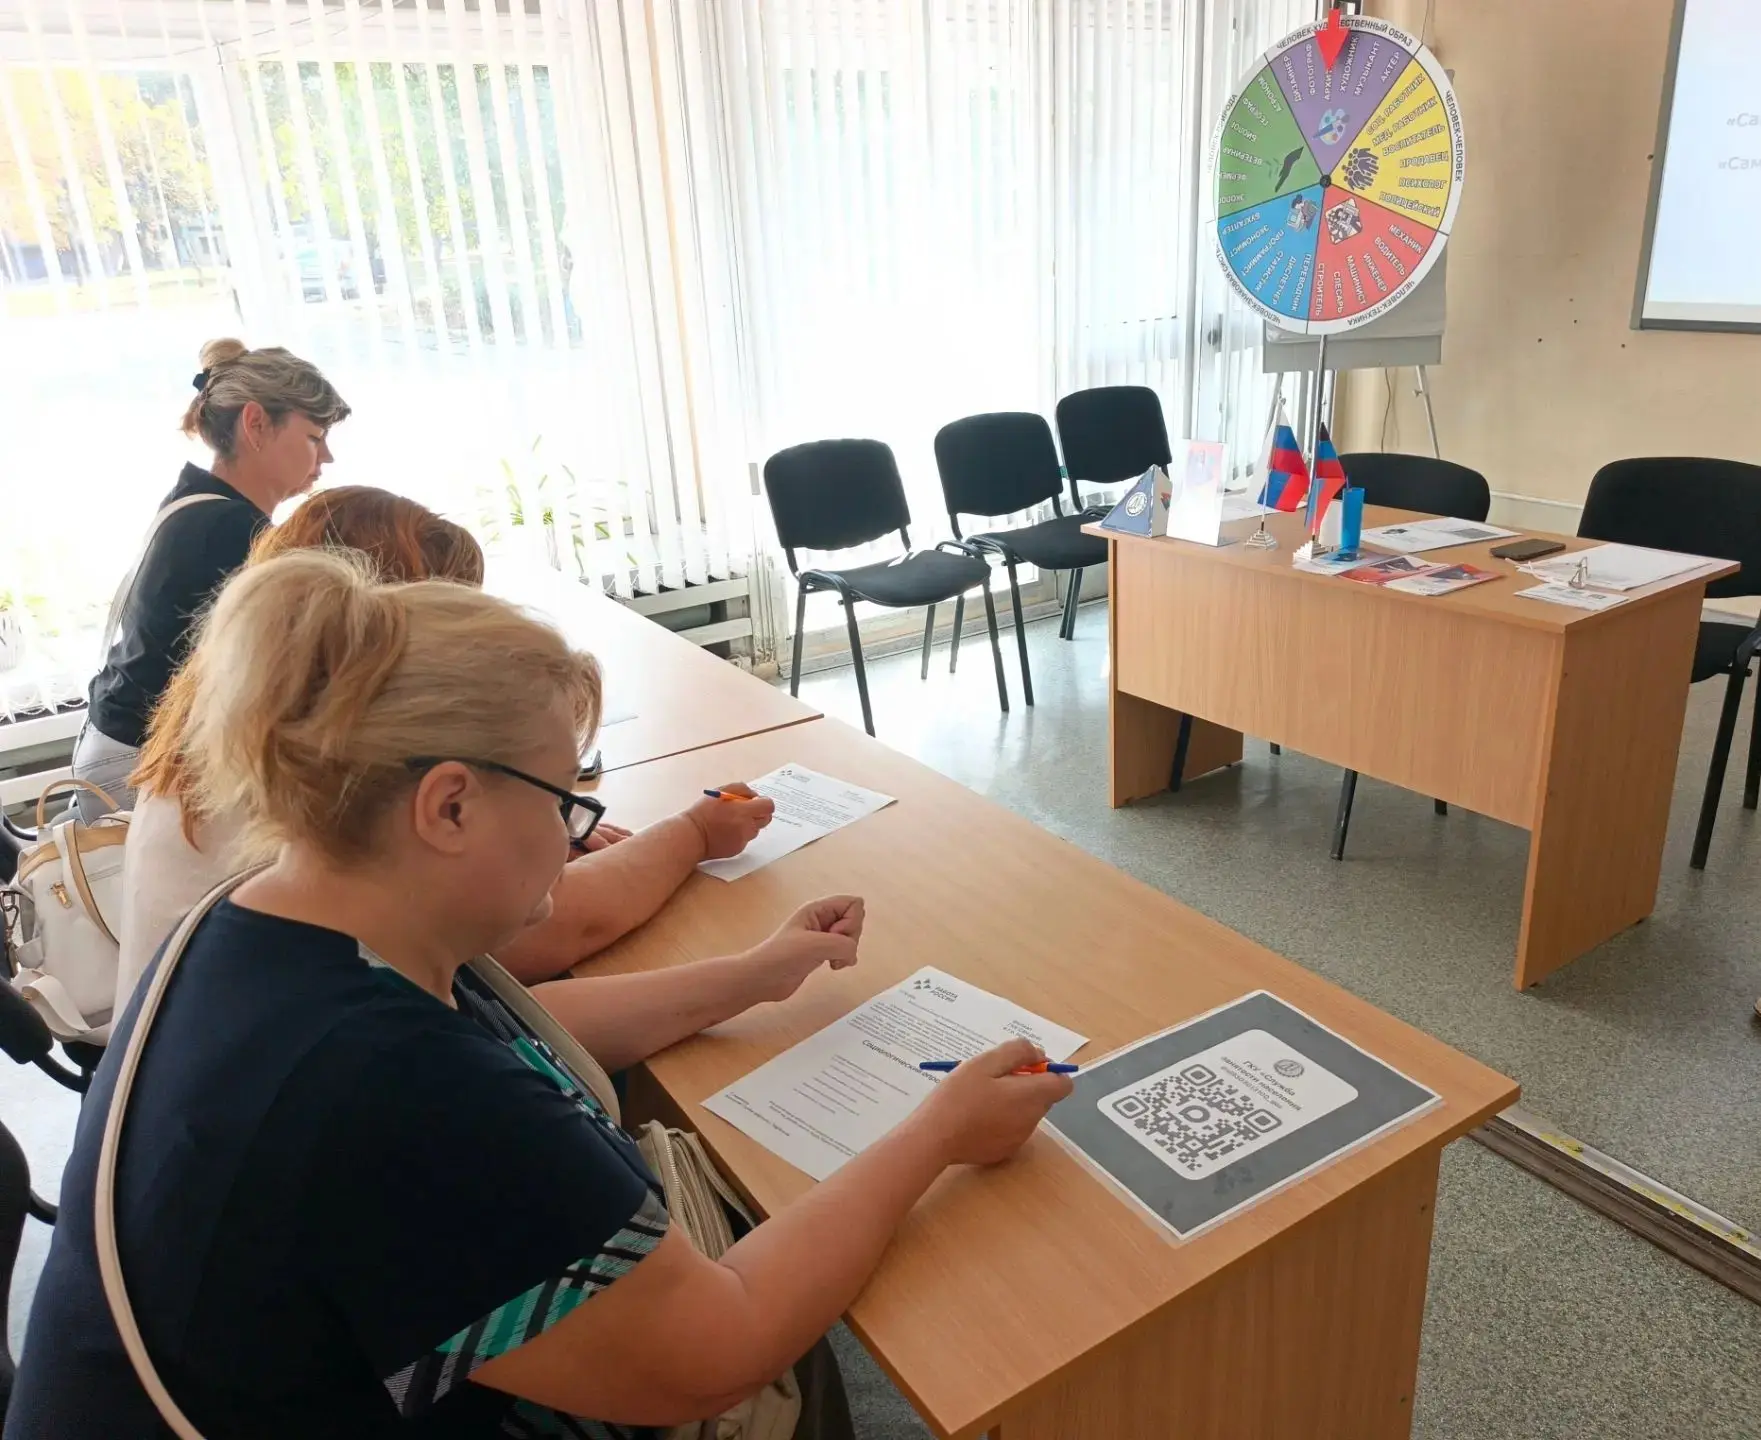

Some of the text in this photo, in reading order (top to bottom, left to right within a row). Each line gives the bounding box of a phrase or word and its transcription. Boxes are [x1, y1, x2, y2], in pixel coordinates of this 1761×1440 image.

[1277, 19, 1413, 49] ЧЕЛОВЕК-ХУДЕСТВЕННЫЙ ОБРАЗ
[1283, 55, 1303, 102] ДИЗАЙНЕР
[1305, 43, 1316, 96] ФОТОГРАФ
[1340, 37, 1359, 93] ХУДОЖНИК
[1354, 41, 1381, 96] МУЗЫКАНТ
[1380, 51, 1401, 82] АКТЕР
[1258, 76, 1283, 113] АГРОНОМ
[1384, 73, 1426, 117] РАБОТНИК
[1392, 95, 1438, 133] РАБОТНИК
[1222, 146, 1263, 165] ВЕТЕРИНАР
[1382, 123, 1446, 156] ВОСПИТАТЕЛЬ
[1445, 90, 1464, 182] ЧЕЛОВЕК-ЧЕЛОВЕК
[1399, 150, 1449, 168] ПРОДАВЕЦ
[1398, 177, 1448, 190] ПСИХОЛОГ
[1222, 212, 1261, 236] БУХГАЛТЕР
[1378, 190, 1441, 218] ПОЛИЦЕЙСКИЙ
[1229, 224, 1270, 258] ЭКОНОМИСТ
[1242, 229, 1285, 277] ПРОГРАММИСТ
[1374, 236, 1405, 276] ВОДИТЕЛЬ
[1388, 224, 1424, 254] МЕХАНИК
[1254, 250, 1284, 293] СТАТИСТИК
[1272, 255, 1297, 305] ДИСПЕТЧЕР
[1291, 253, 1312, 312] ПЕРЕВОДЧИК
[1315, 262, 1325, 316] СТРОИТЕЛЬ
[1346, 255, 1367, 305] МАШИНИСТ
[1362, 252, 1388, 292] ИНЖЕНЕР
[1225, 271, 1281, 324] ЧЕЛОВЕК-ЗНАКОВАЯ
[1333, 271, 1345, 314] СЛЕСАРЬ
[1347, 280, 1415, 326] ЧЕЛОВЕК-ТЕХНИКА
[921, 1069, 941, 1084] опро
[1243, 1060, 1260, 1072] ГКУ
[1260, 1070, 1295, 1096] «Служба
